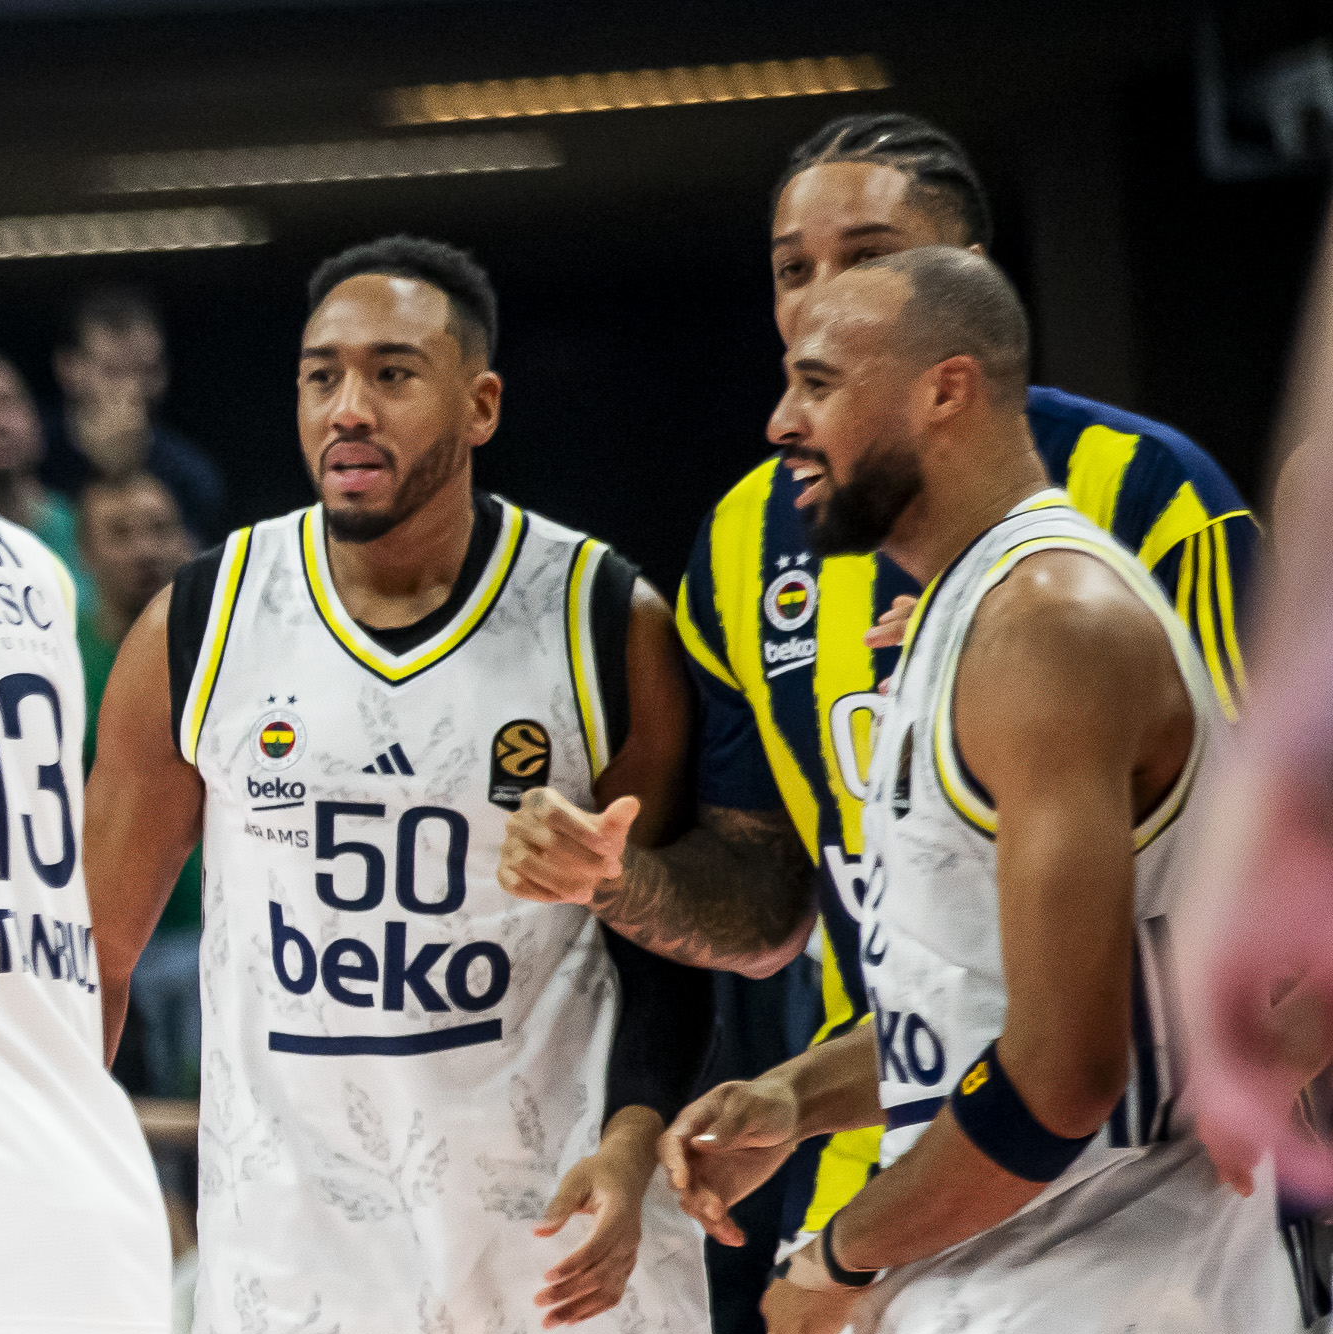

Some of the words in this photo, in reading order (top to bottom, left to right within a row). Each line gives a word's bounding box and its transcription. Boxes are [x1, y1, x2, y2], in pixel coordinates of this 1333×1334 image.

[247, 774, 306, 799] beko
[314, 800, 470, 916] 50
[268, 900, 512, 1014] beko
